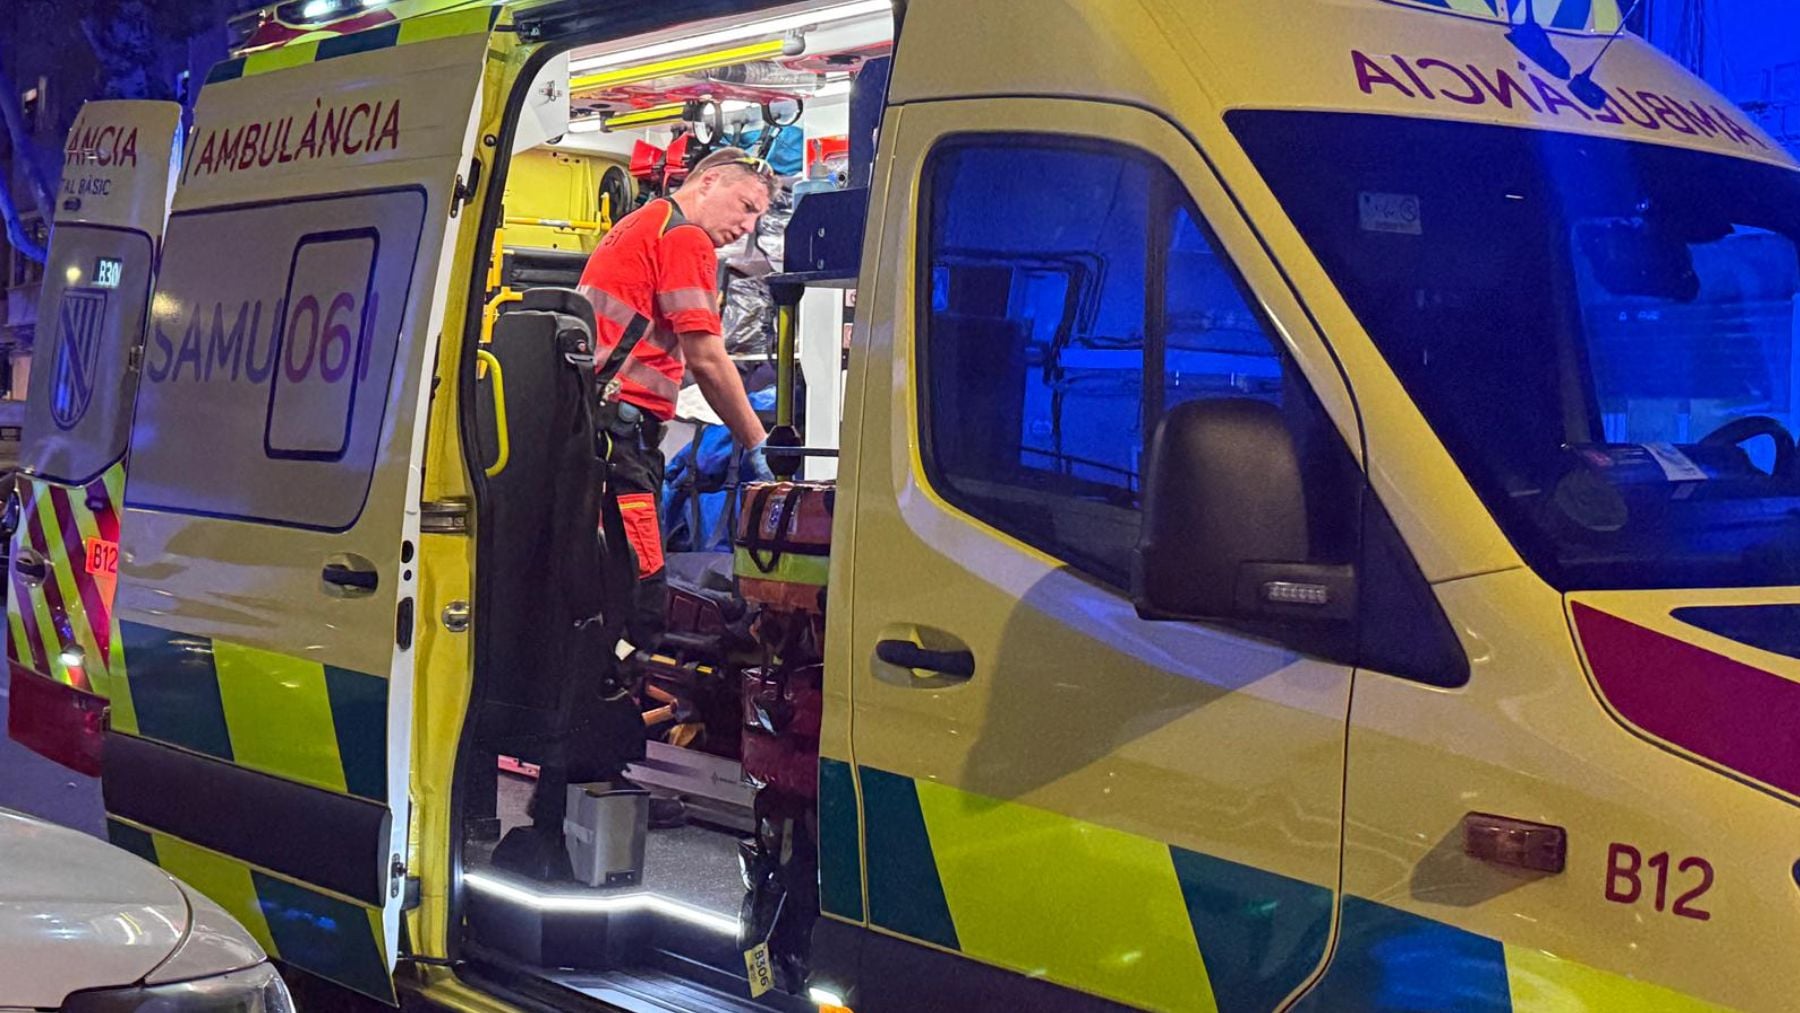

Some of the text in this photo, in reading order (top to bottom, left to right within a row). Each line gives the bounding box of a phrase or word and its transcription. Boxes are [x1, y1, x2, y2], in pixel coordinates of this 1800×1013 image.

[194, 97, 400, 176] AMBULÀNCIA
[93, 543, 119, 574] B12
[1605, 842, 1714, 921] B12
